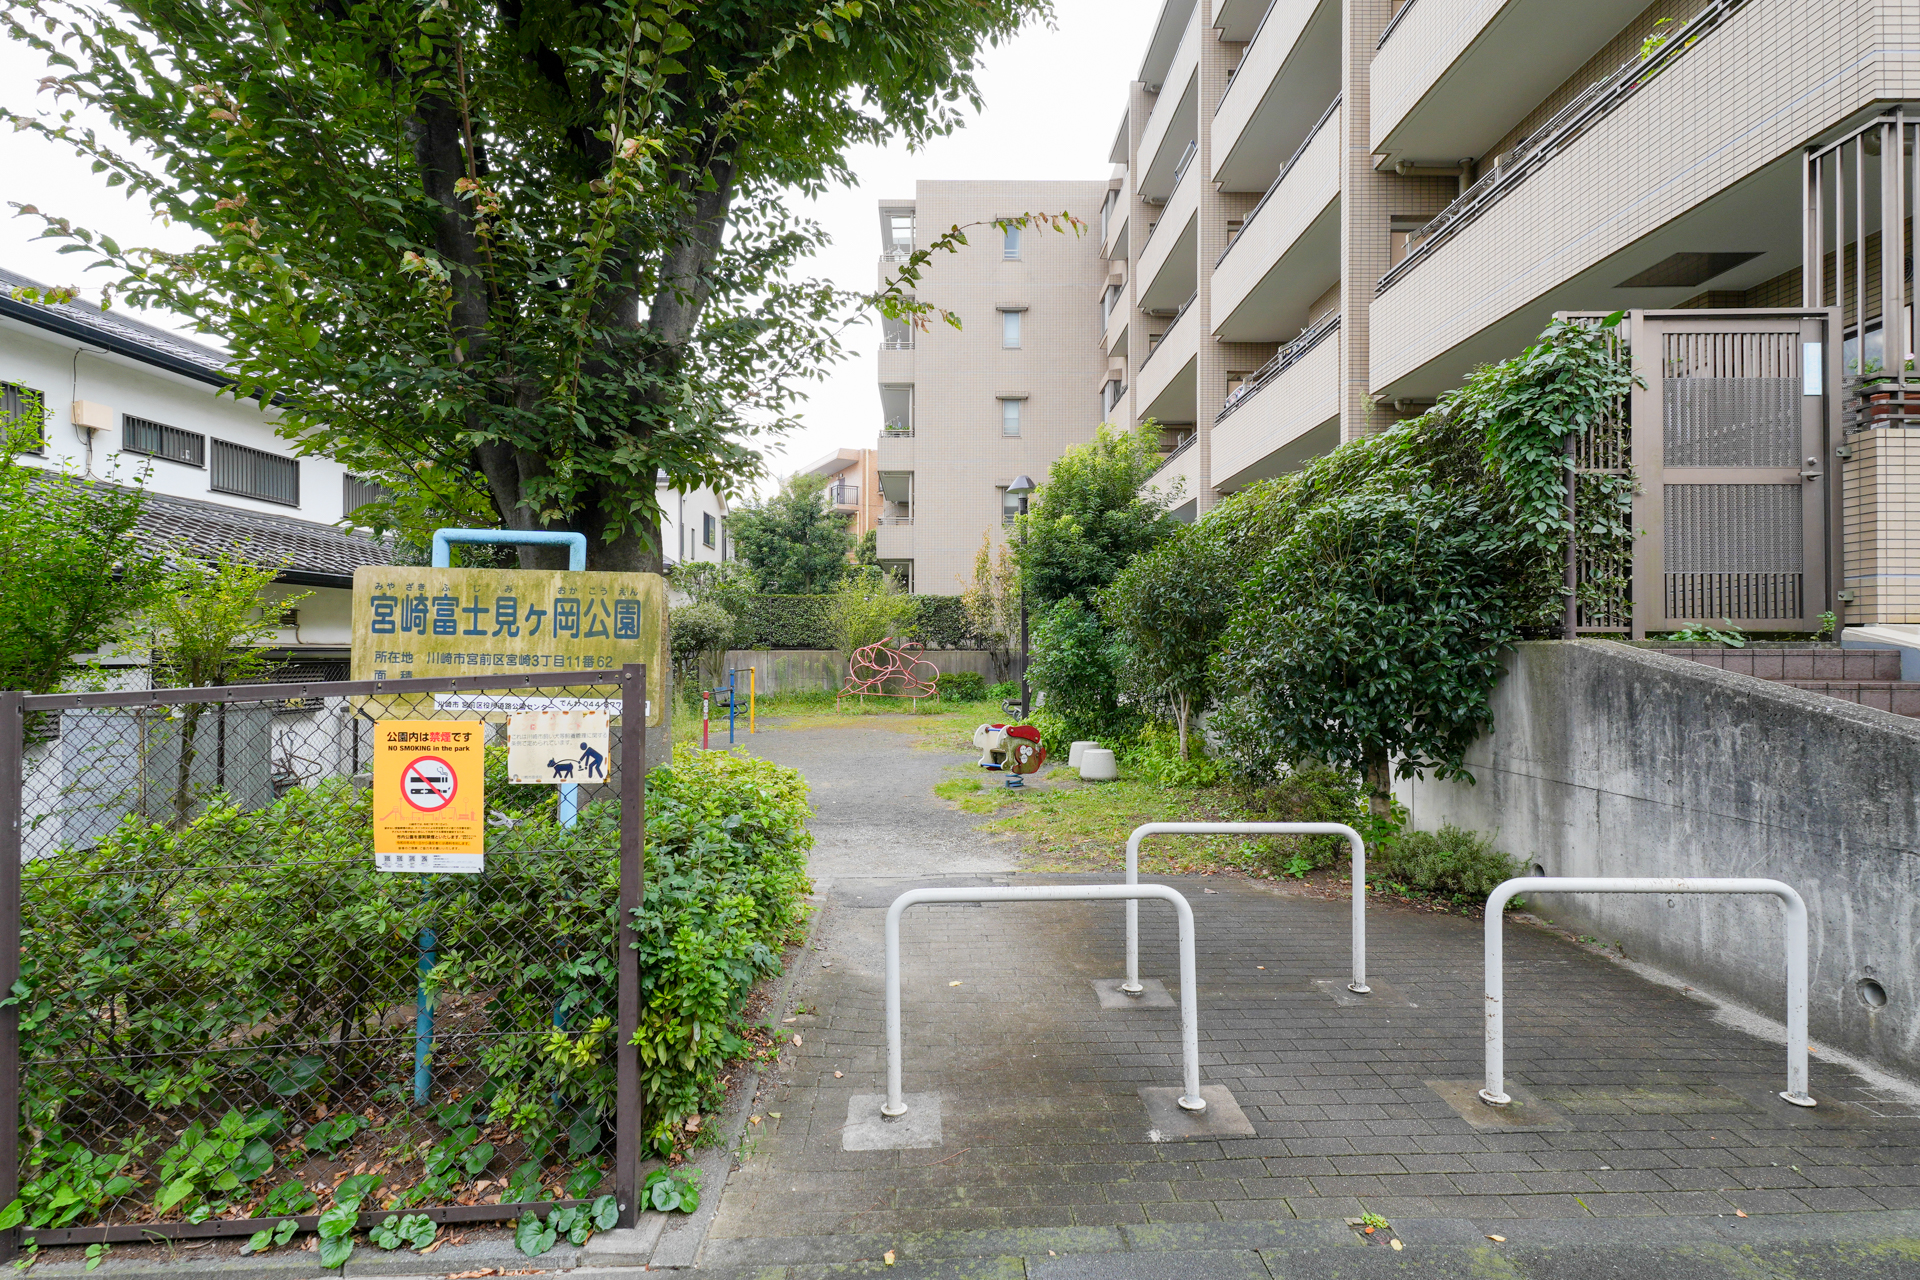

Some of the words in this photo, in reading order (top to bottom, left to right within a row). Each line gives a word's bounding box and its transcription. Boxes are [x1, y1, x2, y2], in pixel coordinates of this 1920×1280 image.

[374, 650, 414, 664] 所在地
[386, 731, 473, 743] 公園内は禁煙です
[454, 745, 470, 753] park
